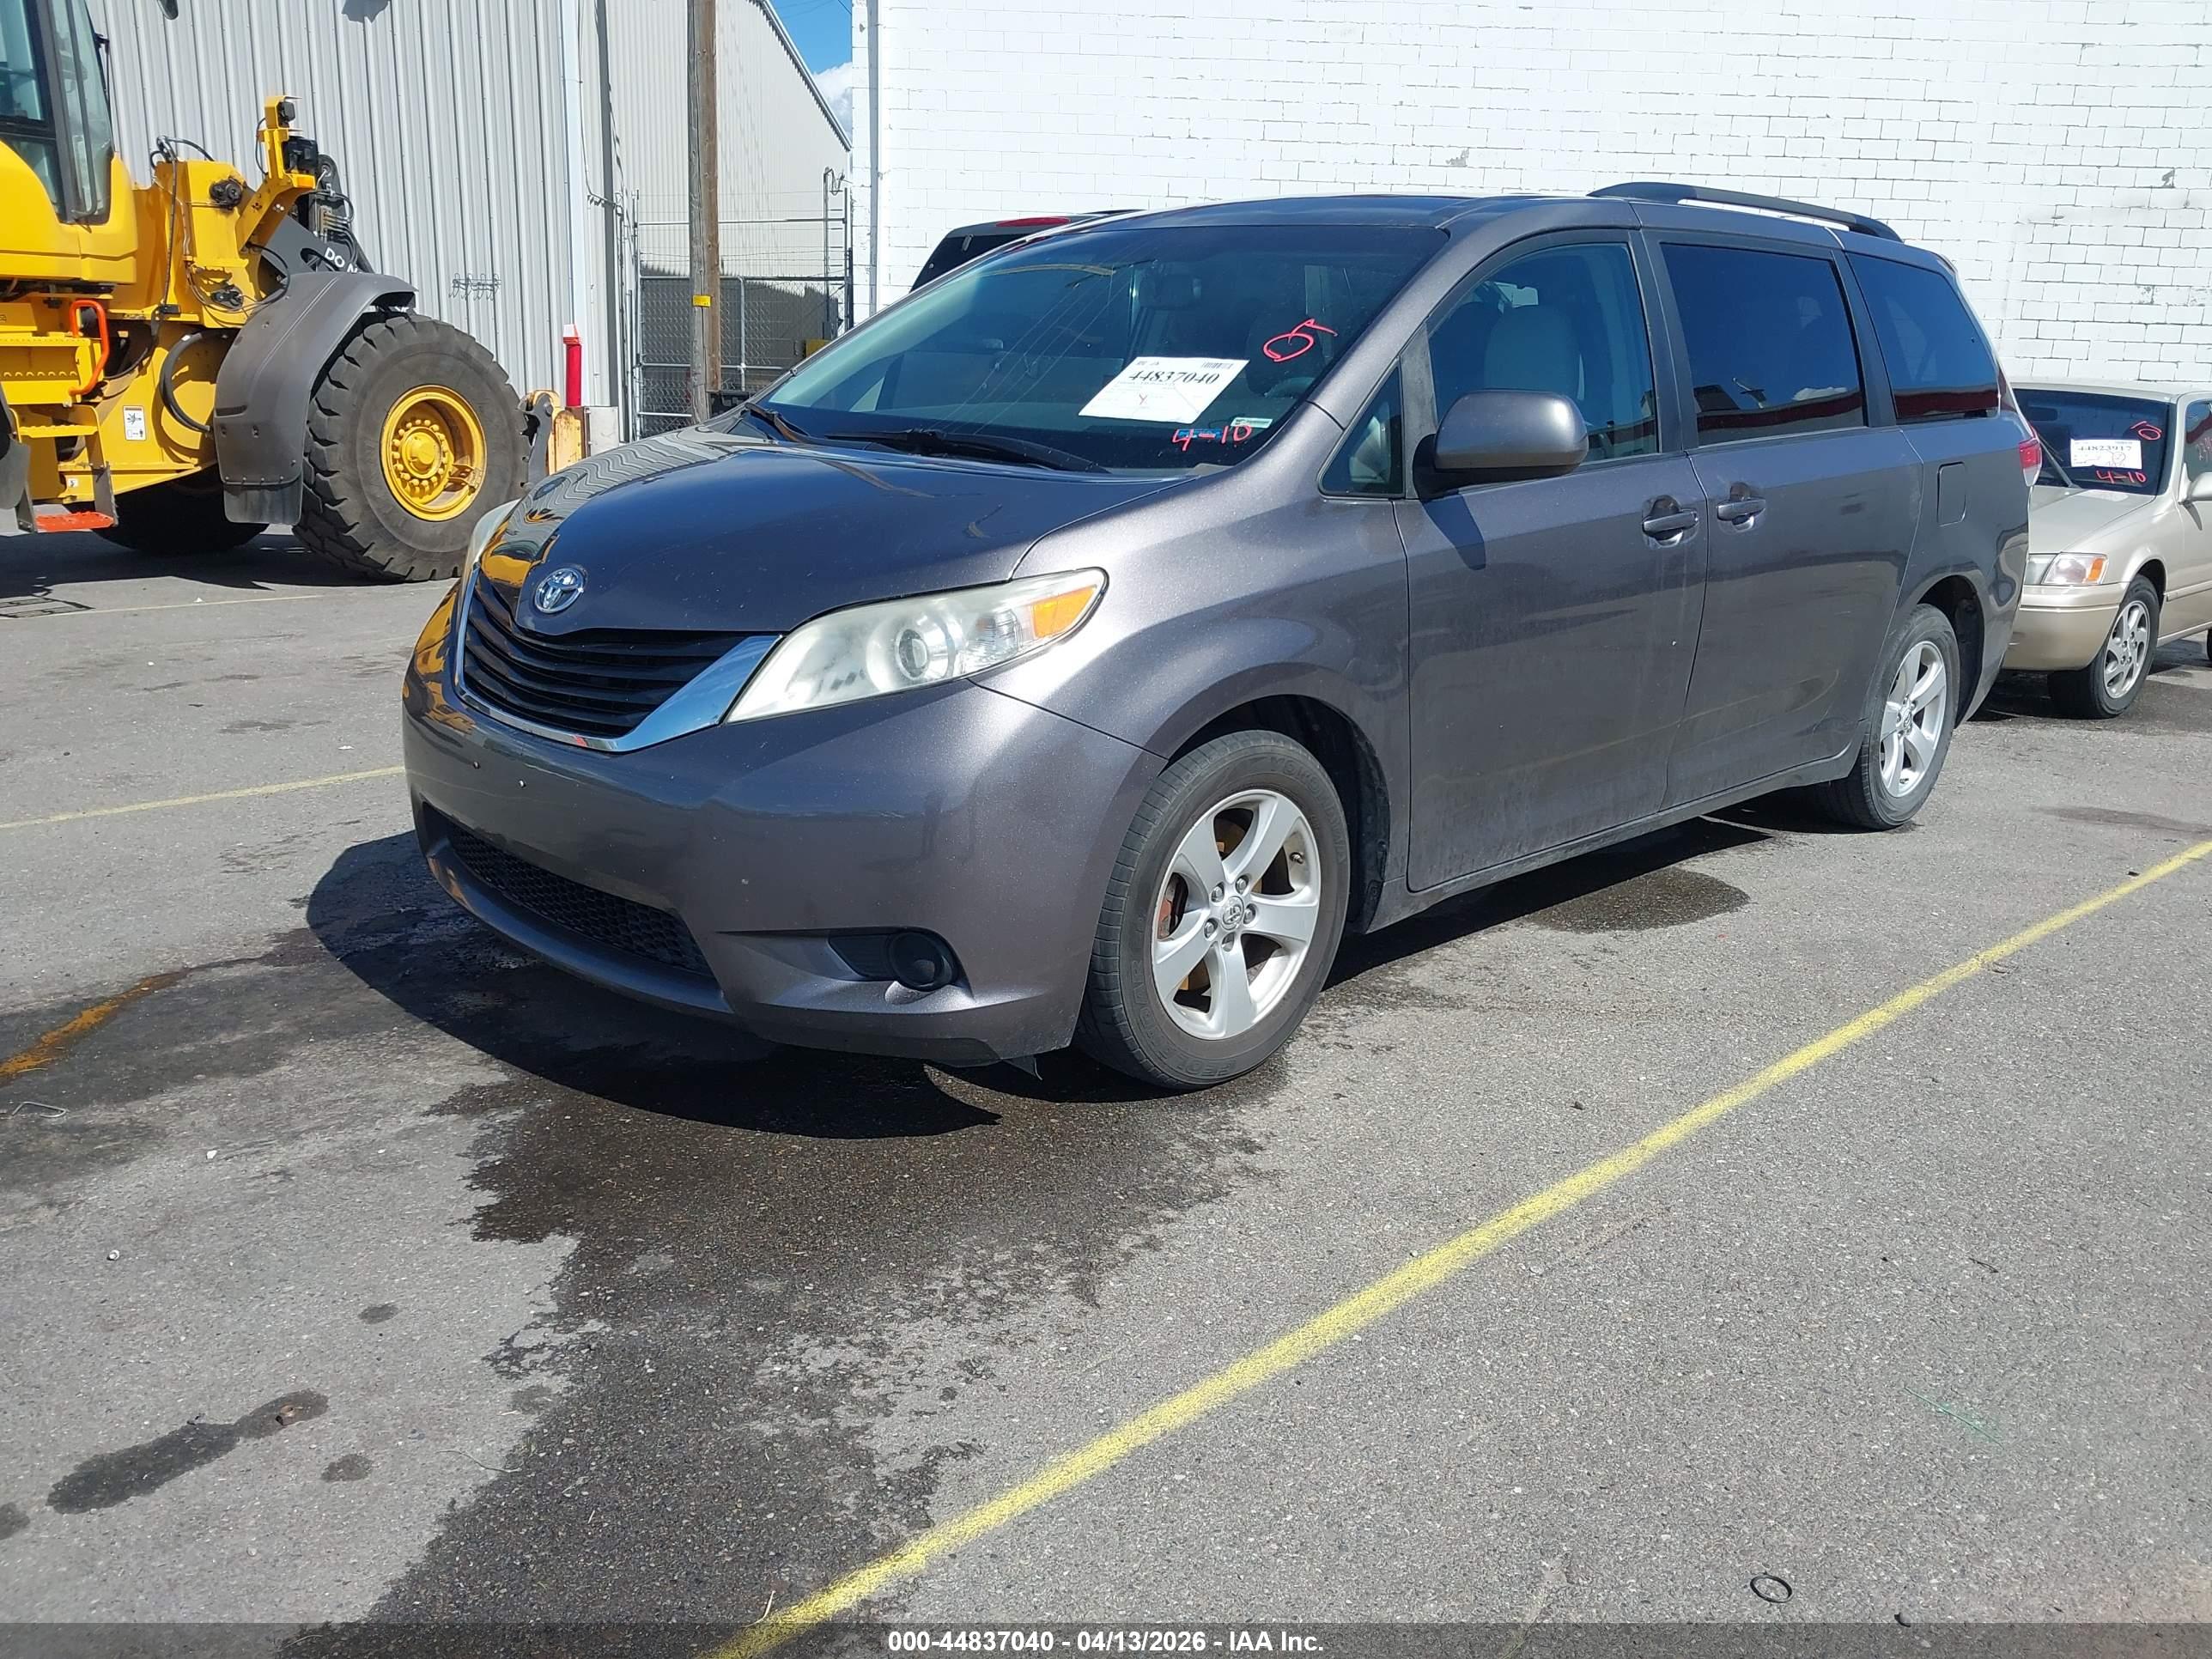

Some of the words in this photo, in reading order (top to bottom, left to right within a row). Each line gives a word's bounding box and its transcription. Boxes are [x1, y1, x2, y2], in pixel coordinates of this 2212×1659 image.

[325, 247, 344, 267] DO
[1129, 370, 1220, 385] 44837040
[1172, 425, 1252, 452] 4-10
[2096, 470, 2147, 483] 4-10
